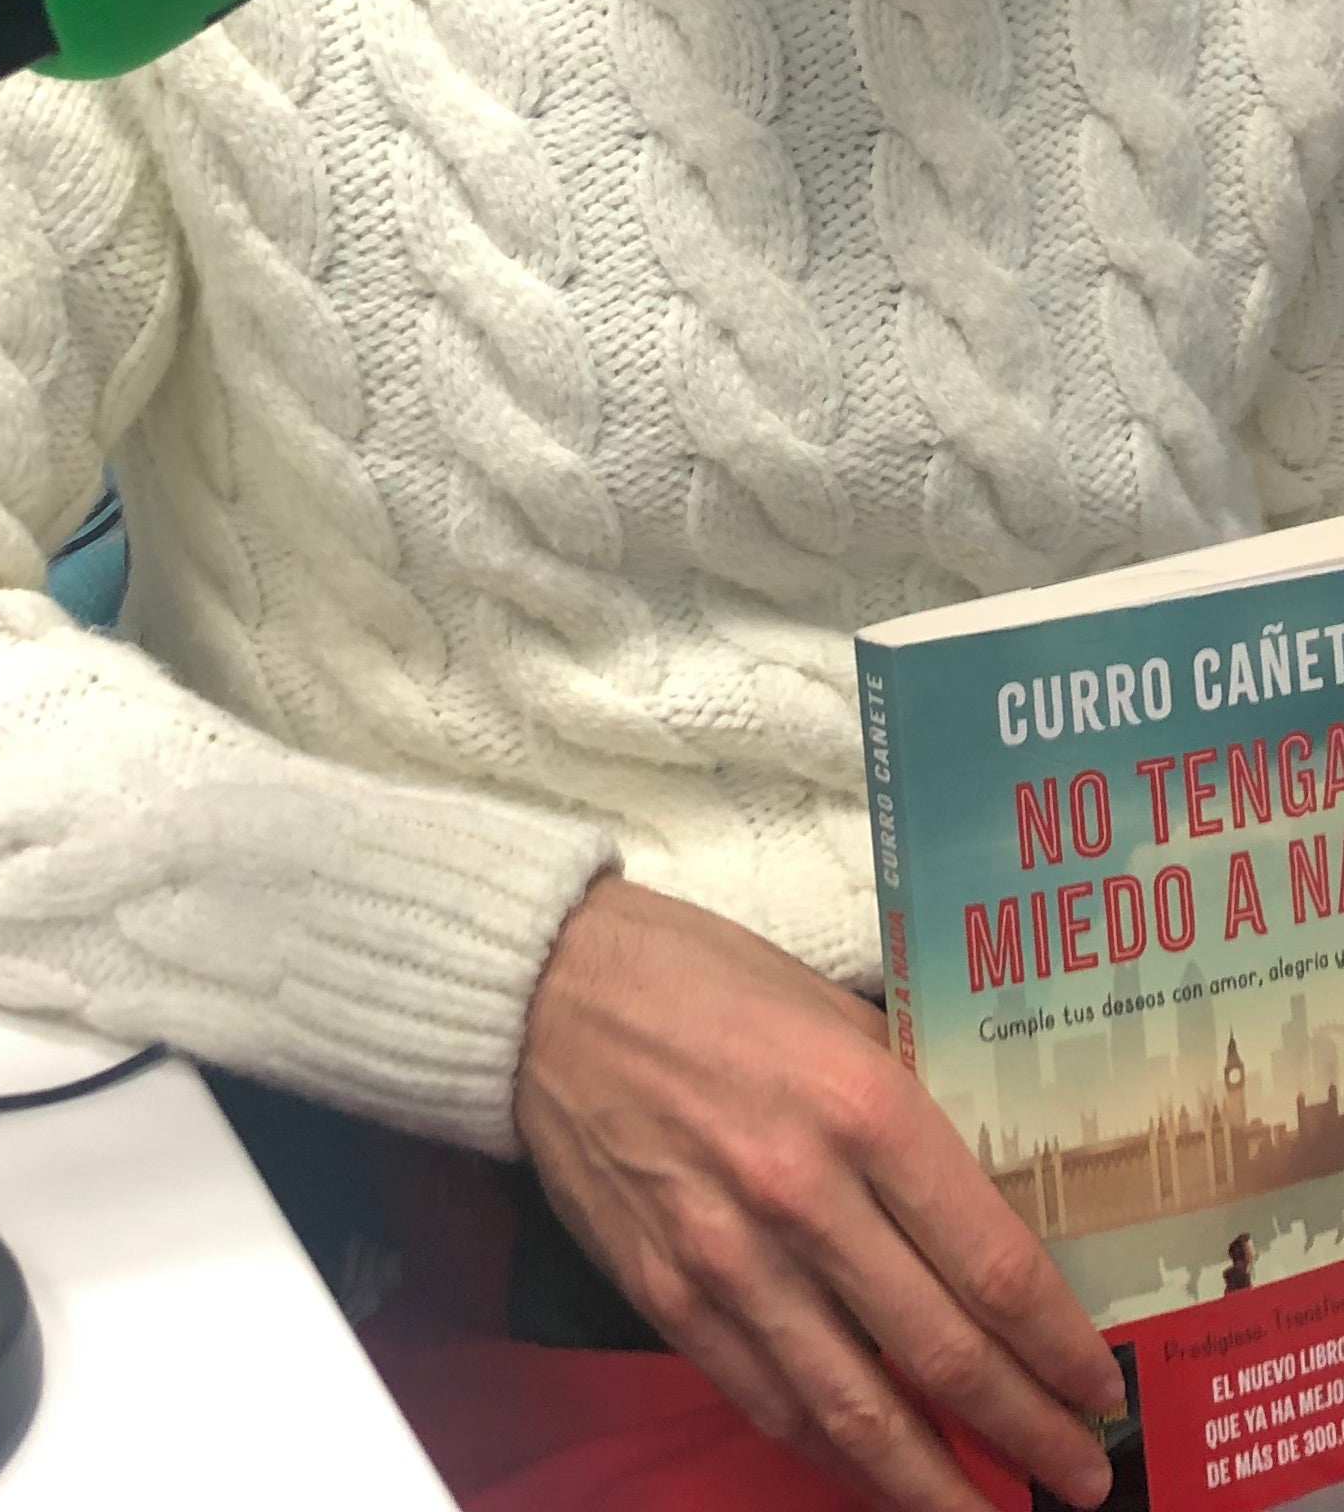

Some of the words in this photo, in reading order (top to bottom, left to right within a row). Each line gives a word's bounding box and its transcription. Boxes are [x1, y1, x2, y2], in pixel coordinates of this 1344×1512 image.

[866, 672, 892, 784] CAÑETE
[997, 657, 1173, 746] CURRO
[876, 792, 900, 890] CURRO
[1014, 769, 1113, 870] NO
[887, 910, 909, 982] NADA
[964, 864, 1196, 994] MIEDO
[1223, 850, 1268, 942] A
[894, 986, 911, 1007] A
[979, 1006, 1056, 1042] Cumple
[1063, 1004, 1095, 1026] tus
[1102, 990, 1166, 1018] deseos
[1172, 982, 1204, 1004] con
[1209, 970, 1264, 996] amor,
[897, 1008, 916, 1073] IEDO
[1212, 1373, 1234, 1404] EL
[1237, 1353, 1296, 1396] NUEVO
[1205, 1412, 1242, 1450] QUE
[1244, 1404, 1268, 1435] YA
[1271, 1395, 1296, 1427] HA
[1206, 1456, 1232, 1490] DE
[1234, 1442, 1274, 1481] MÁS
[1277, 1434, 1301, 1466] DE
